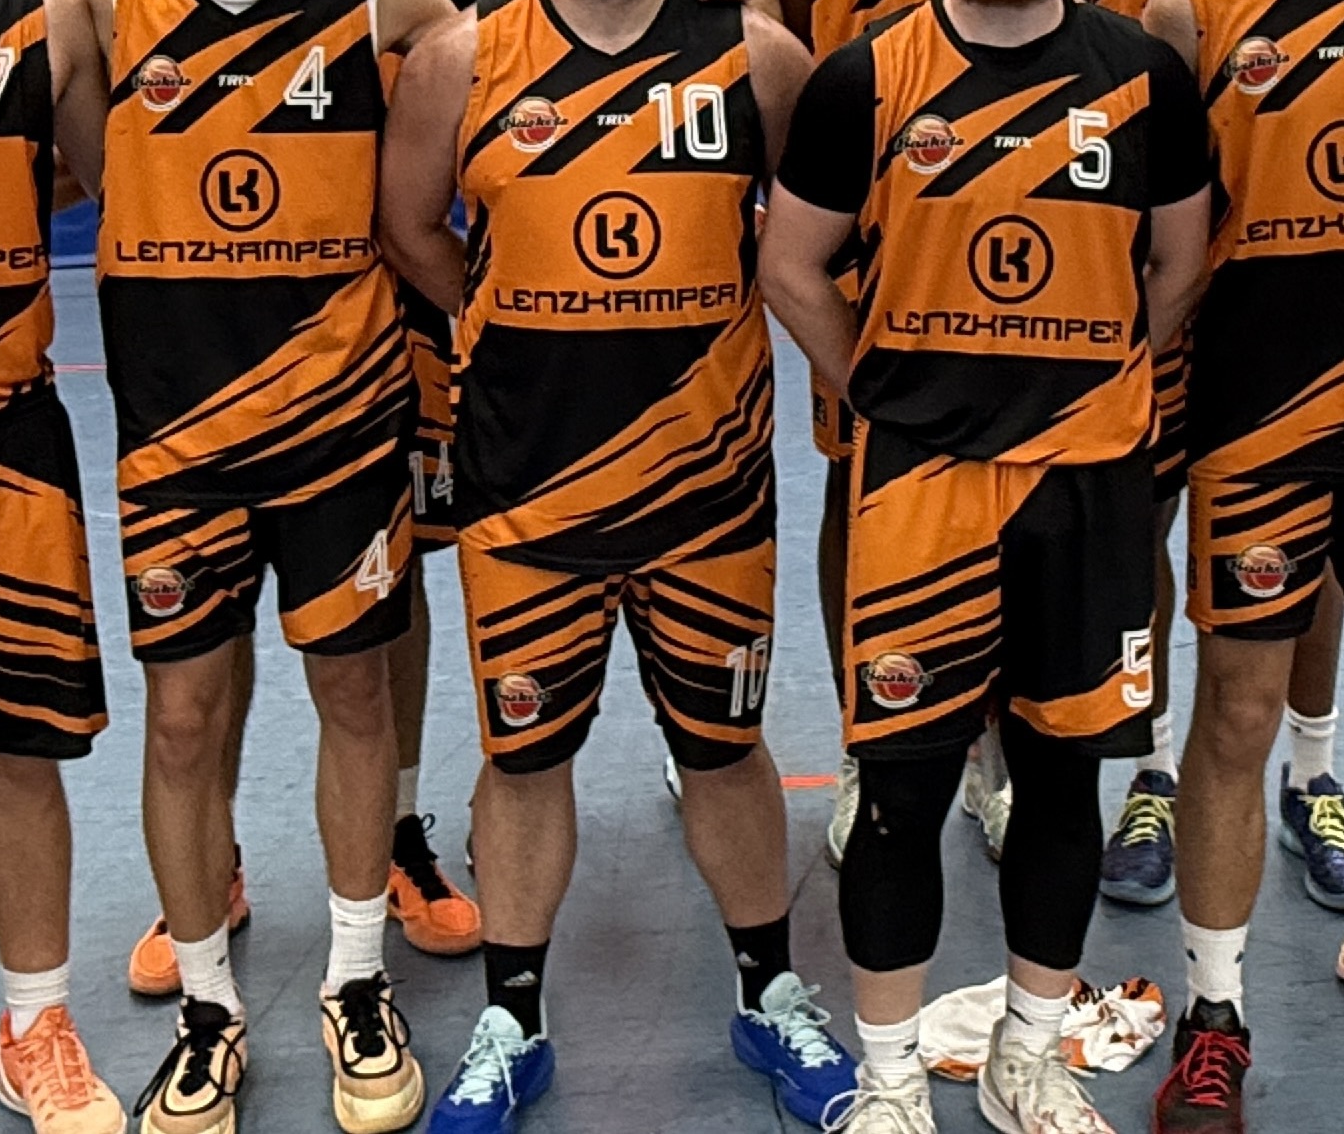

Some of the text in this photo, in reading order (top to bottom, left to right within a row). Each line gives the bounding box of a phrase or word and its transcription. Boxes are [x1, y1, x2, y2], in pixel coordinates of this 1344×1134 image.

[218, 74, 254, 87] TRIX
[283, 45, 333, 120] 4
[647, 82, 729, 160] 10
[994, 135, 1032, 149] TRIX
[1067, 107, 1111, 190] 5
[355, 528, 394, 599] 4
[1121, 628, 1153, 708] 5
